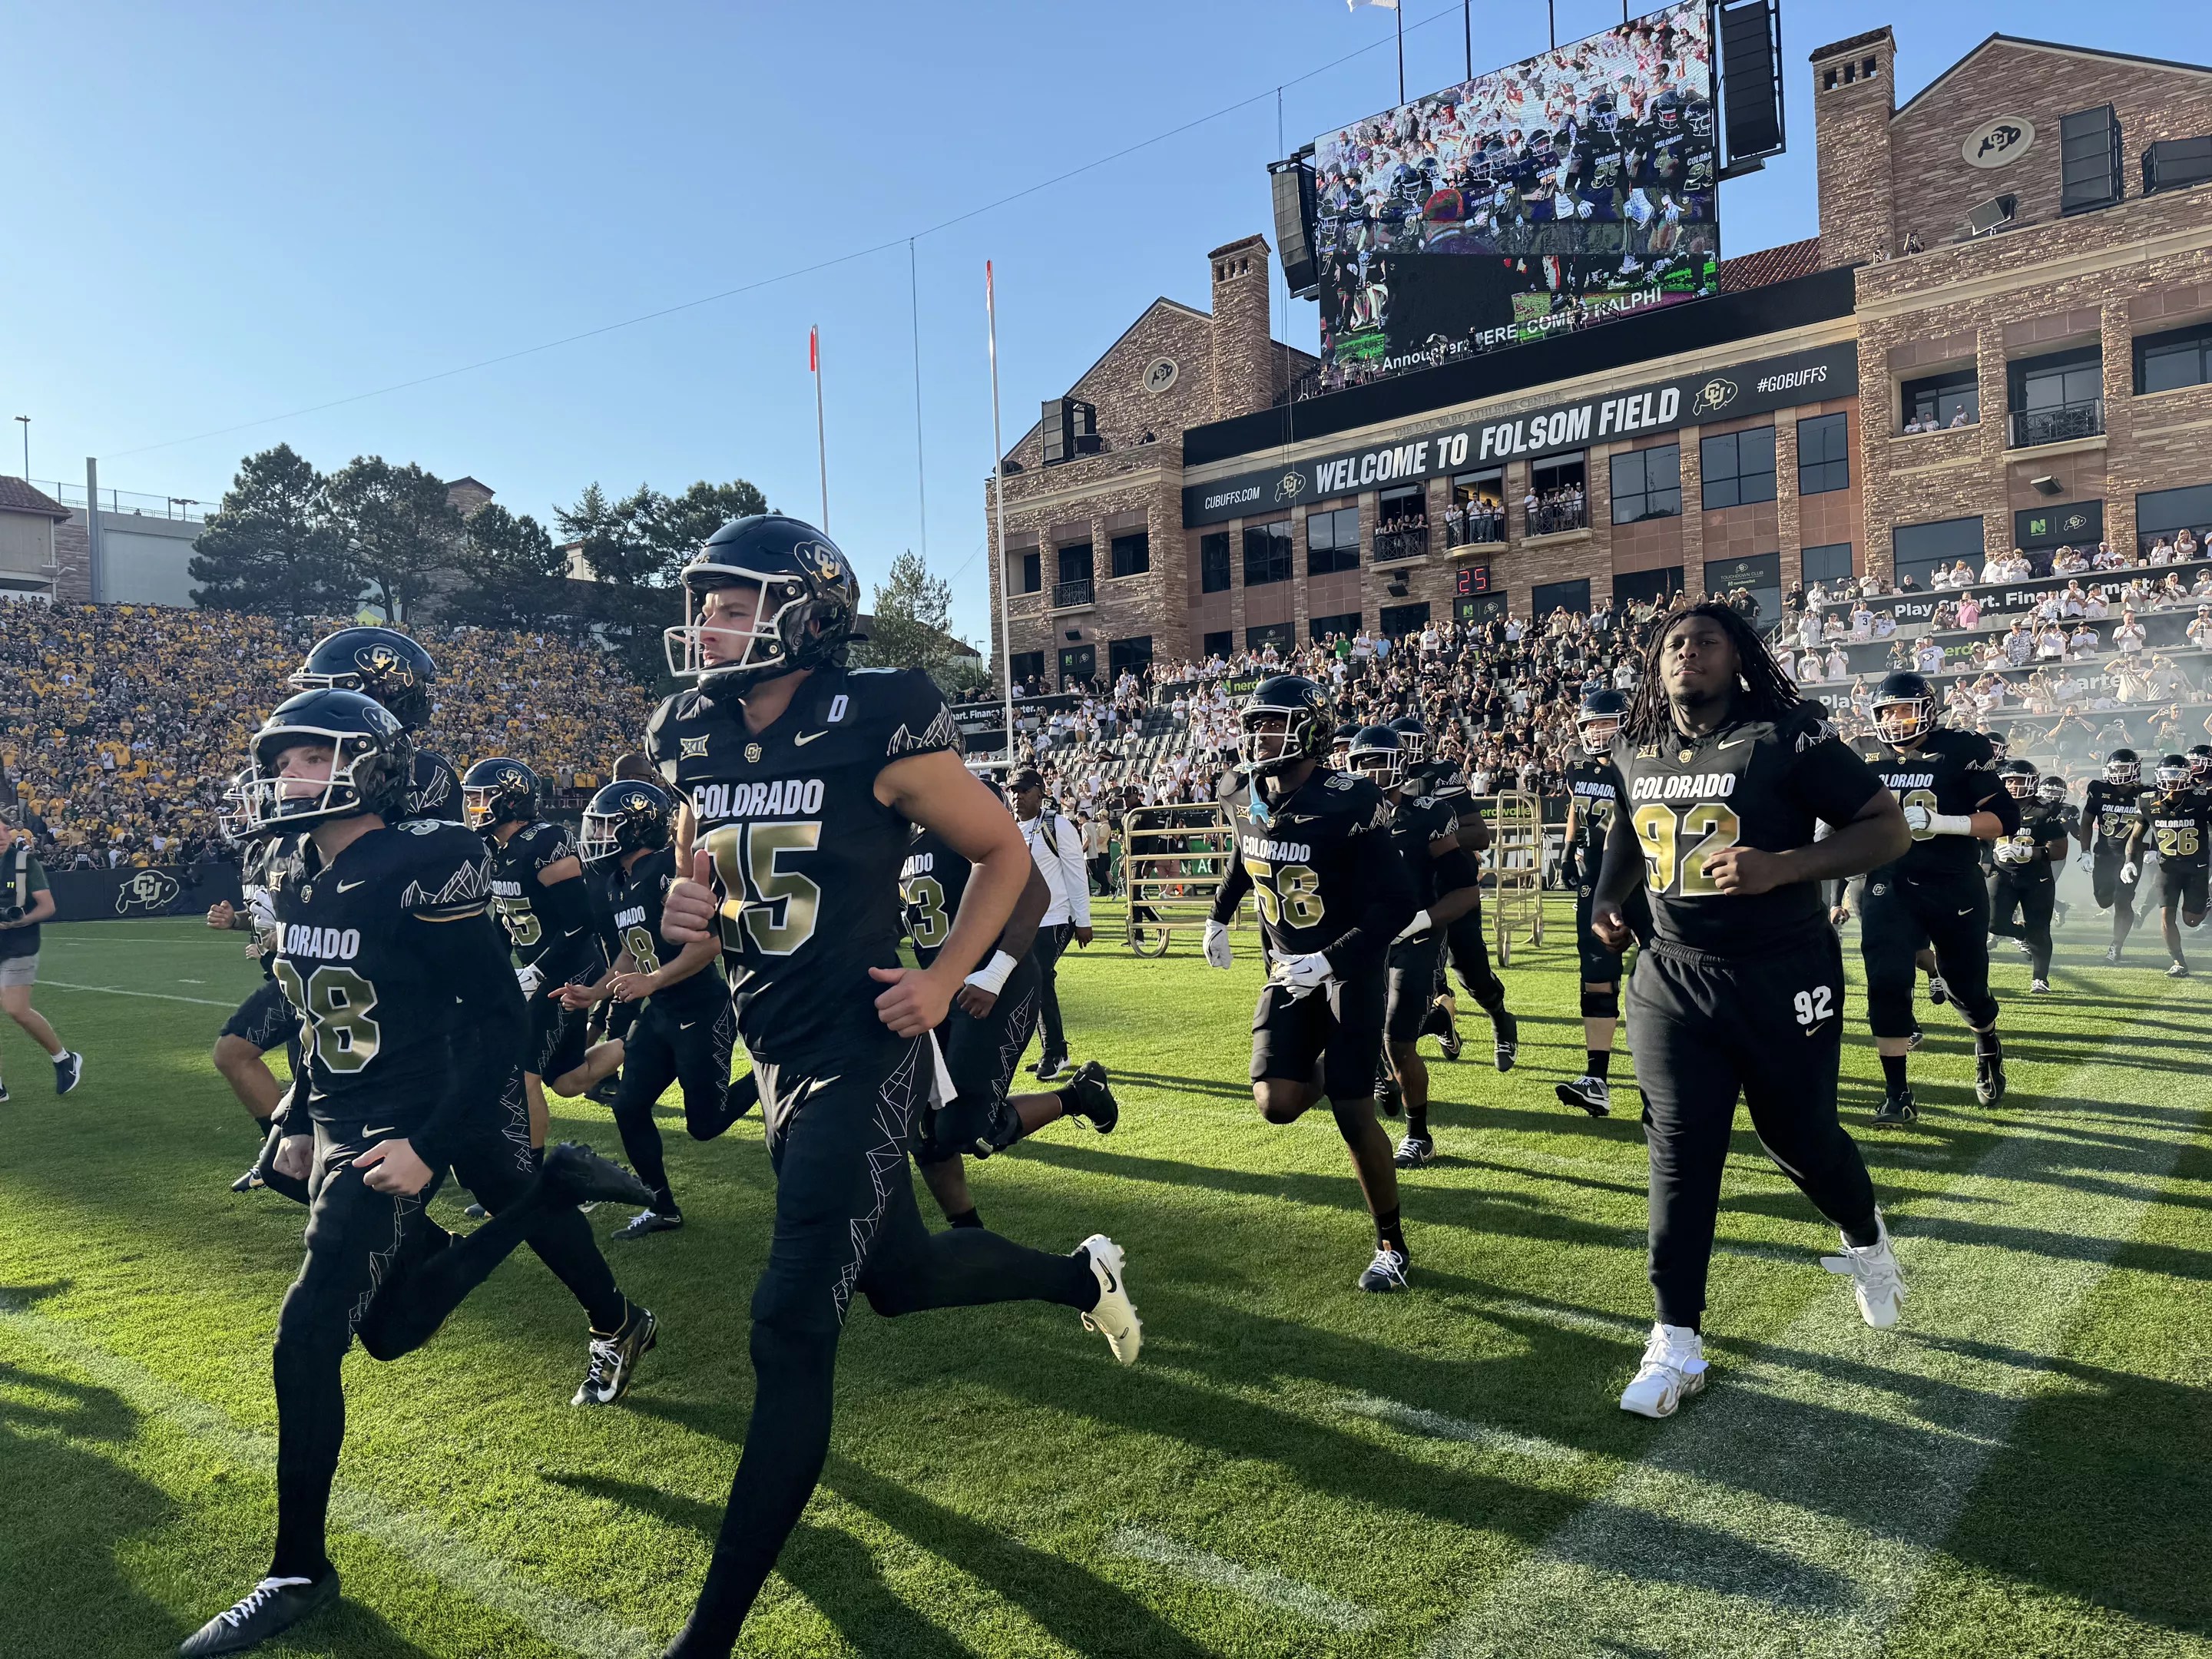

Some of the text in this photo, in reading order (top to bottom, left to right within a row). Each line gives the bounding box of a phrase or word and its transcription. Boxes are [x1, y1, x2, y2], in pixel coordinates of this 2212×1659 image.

[1687, 151, 1711, 166] COLORA
[1475, 323, 1518, 346] ERE
[1757, 366, 1827, 392] #GOBUFFS
[1393, 427, 1412, 437] THE
[1437, 413, 1465, 427] WARD
[1469, 402, 1517, 419] ATHLETIC
[1520, 392, 1561, 406] CENTER
[1316, 387, 1681, 494] WELCOME TO FOLSOM FIELD
[1205, 486, 1260, 510] CUBUFFS.COM
[1459, 568, 1486, 592] 25
[1895, 603, 1932, 618] Play
[827, 694, 849, 722] D
[1819, 694, 1850, 709] Pla
[693, 779, 825, 820] COLORADO
[1631, 773, 1736, 800] COLORADO
[2154, 819, 2195, 828] COLORADO
[1243, 835, 1310, 862] COLORADO
[1632, 803, 1740, 897] 92
[2157, 827, 2199, 856] 26
[696, 821, 823, 955] 15
[1244, 857, 1325, 929] 58
[1793, 985, 1833, 1025] 92
